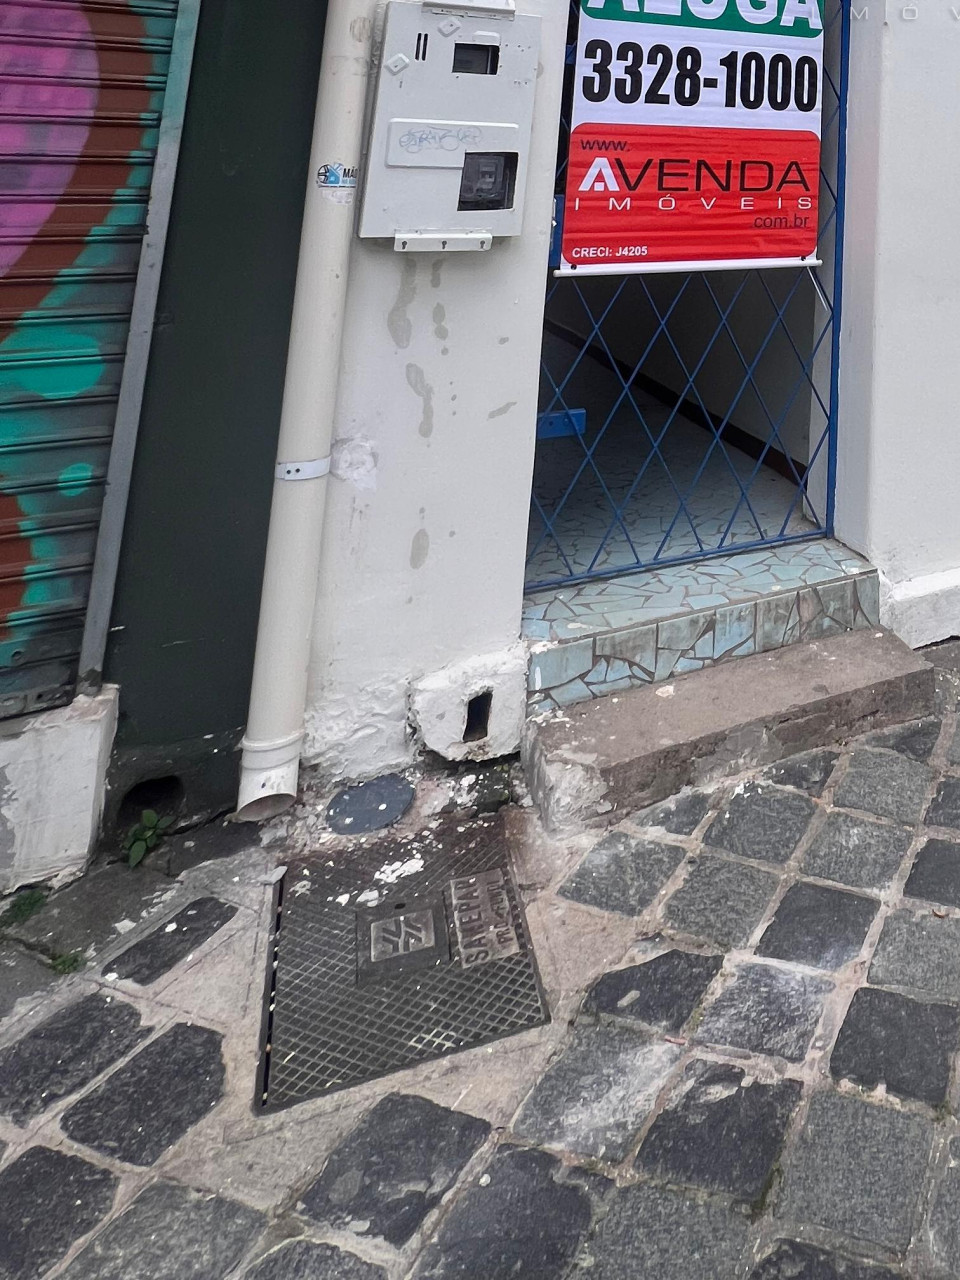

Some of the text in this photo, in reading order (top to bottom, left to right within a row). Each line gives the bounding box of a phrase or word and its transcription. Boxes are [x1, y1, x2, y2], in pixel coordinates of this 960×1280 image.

[581, 38, 819, 112] 3328-1000
[581, 138, 631, 152] www.
[578, 157, 811, 192] AVENDA
[574, 194, 813, 211] IMÓVEIS
[754, 213, 810, 229] com.br
[572, 246, 648, 258] CRECI: J4205
